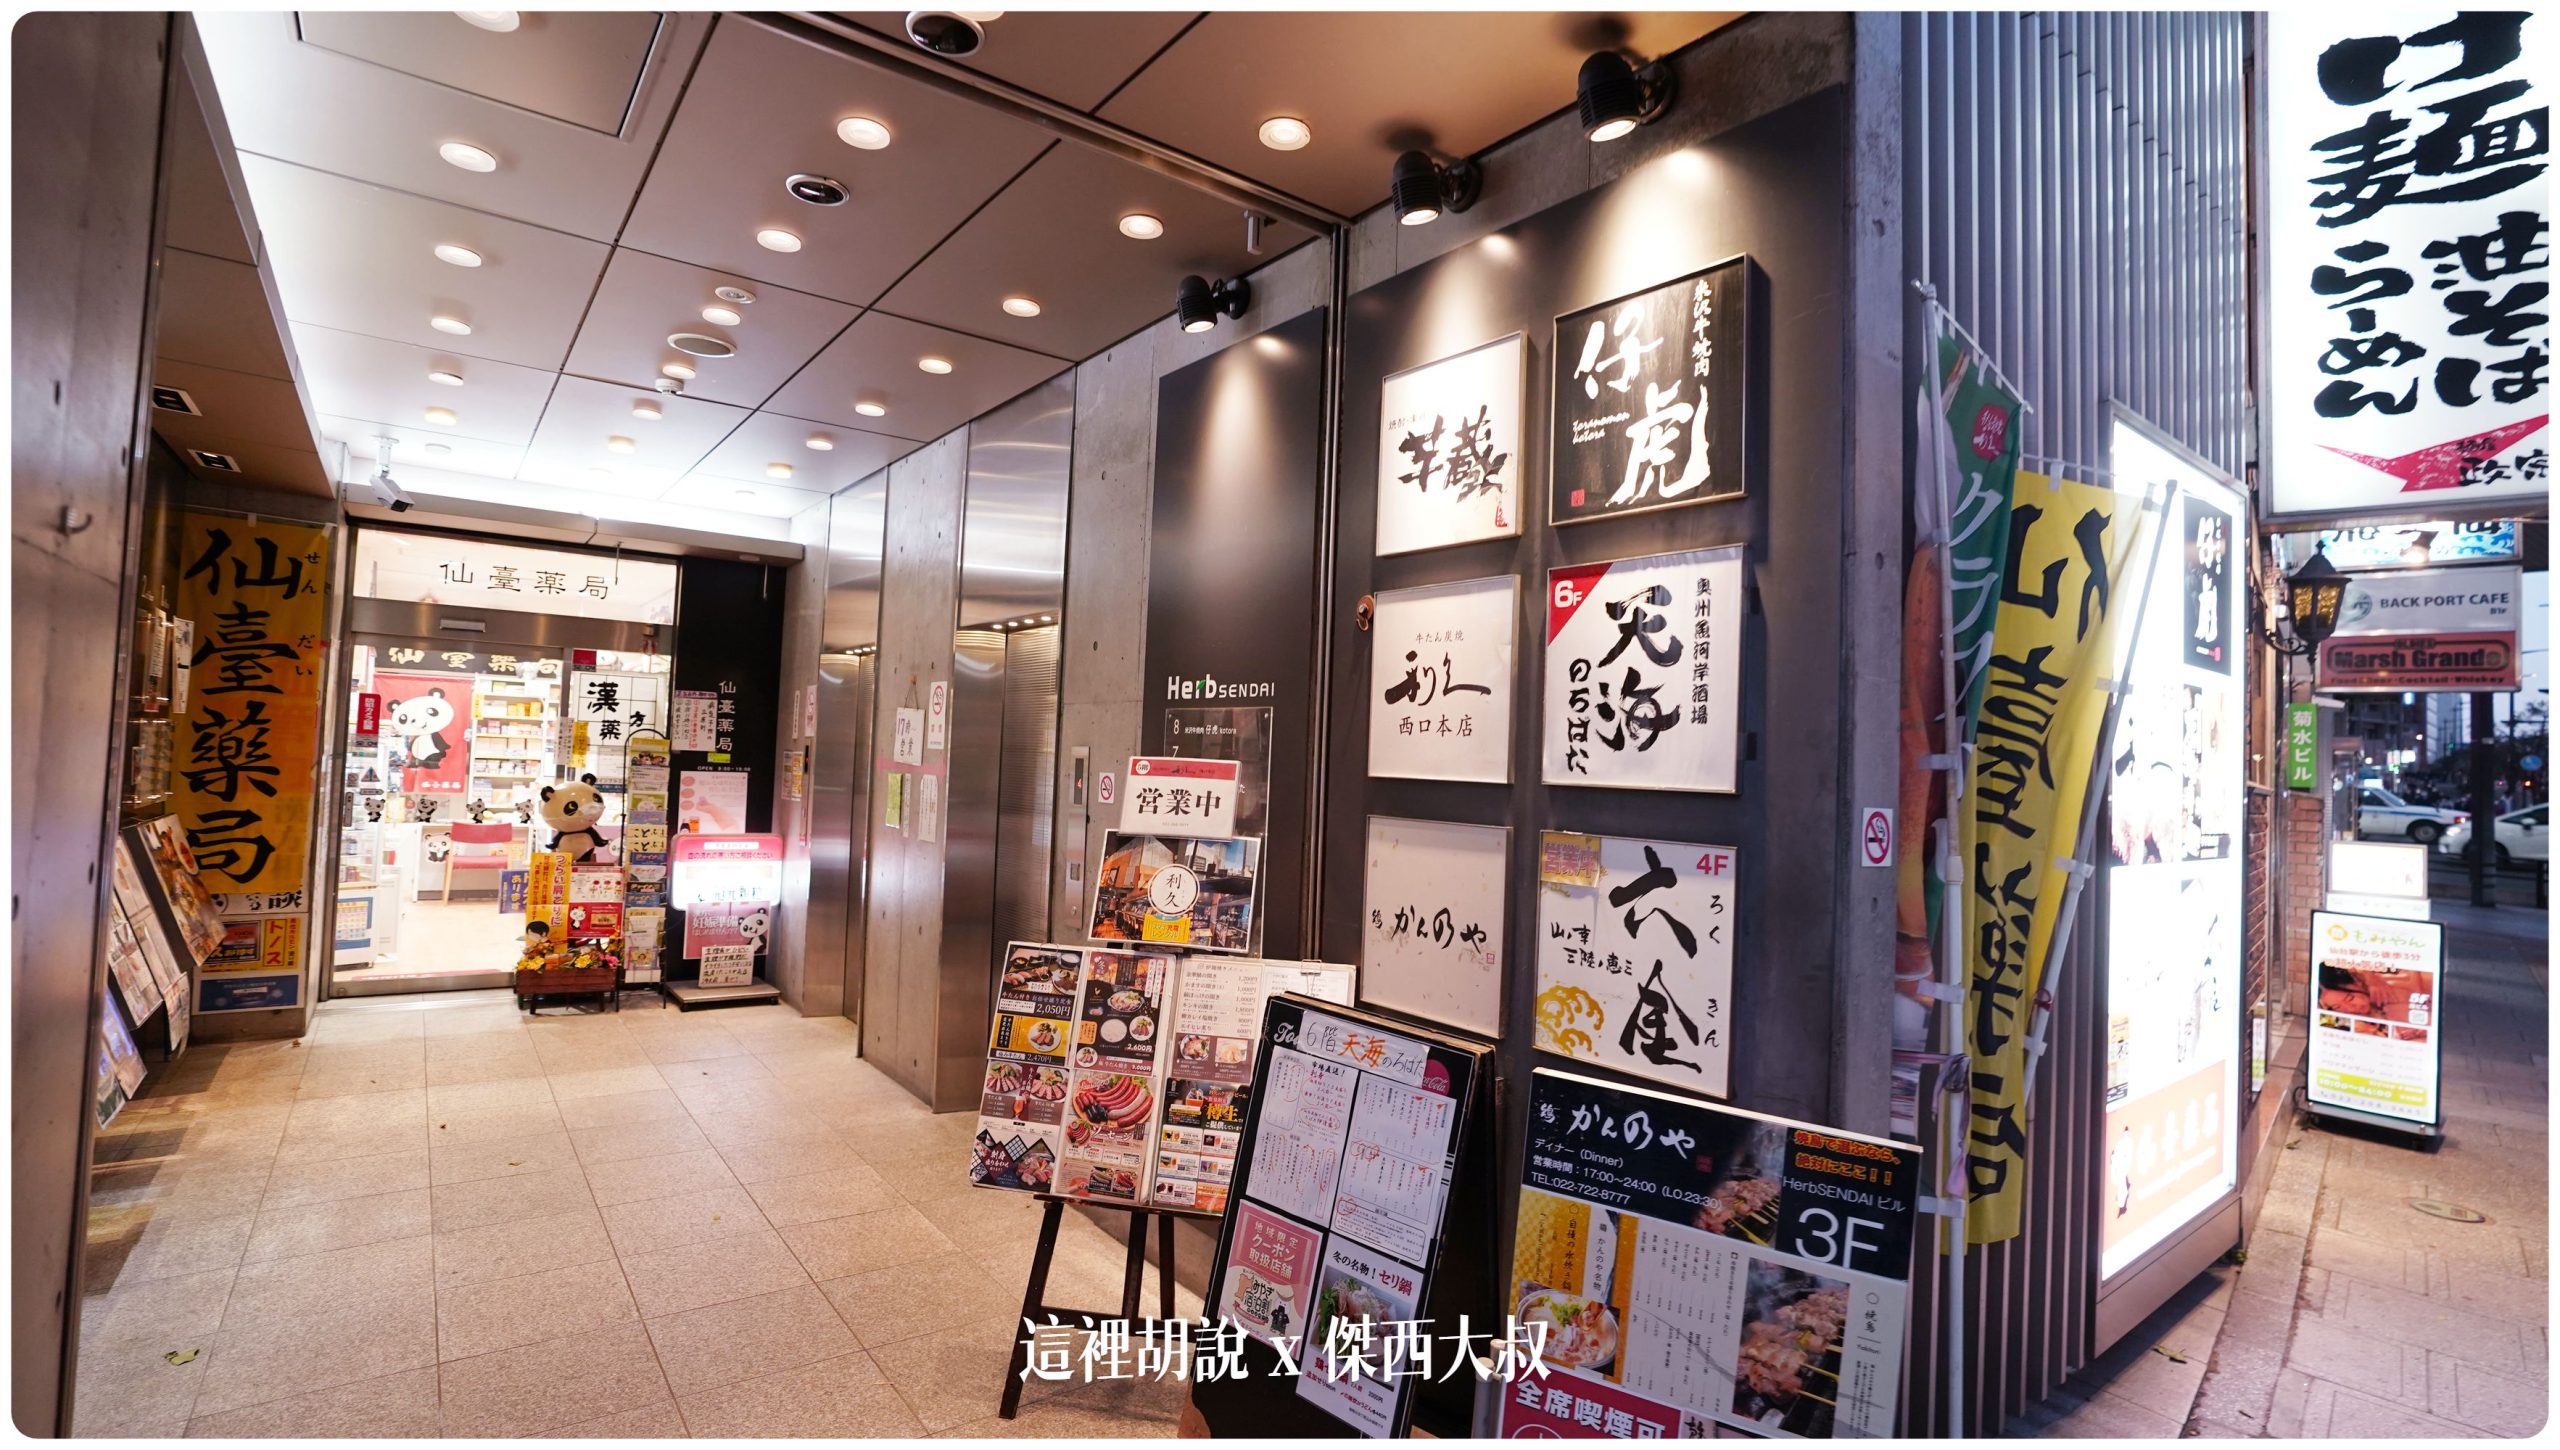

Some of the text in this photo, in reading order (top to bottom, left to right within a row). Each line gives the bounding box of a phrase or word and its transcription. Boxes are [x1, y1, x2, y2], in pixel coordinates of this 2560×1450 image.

[2311, 240, 2427, 418] らーめん
[439, 562, 619, 600] 仙臺薬局
[1554, 579, 1583, 608] 6F
[2380, 592, 2510, 609] BACK PORT CAFE
[1595, 584, 1684, 752] 天海
[1691, 577, 1712, 726] 奥州魚河岸酒場
[2334, 650, 2406, 669] Marsh
[1173, 719, 1180, 735] 8
[1398, 714, 1473, 739] 西口本店
[1172, 745, 1180, 758] 7
[2292, 711, 2312, 781] 菊水ビル
[1136, 787, 1221, 818] 営業中
[1543, 843, 1598, 879] 営業中
[1696, 854, 1729, 876] 4F
[1164, 873, 1182, 908] 利久
[1036, 1004, 1072, 1017] 2,050円
[1530, 1171, 1631, 1206] TEL:022-722-8777
[1782, 1176, 1907, 1213] HerbSENDAI ビル
[1251, 1234, 1296, 1262] クーポン
[1254, 1221, 1299, 1250] 地域限定
[1795, 1207, 1885, 1269] 3F
[1248, 1247, 1293, 1280] 取扱店舗
[1515, 1379, 1666, 1439] 全席喫煙可
